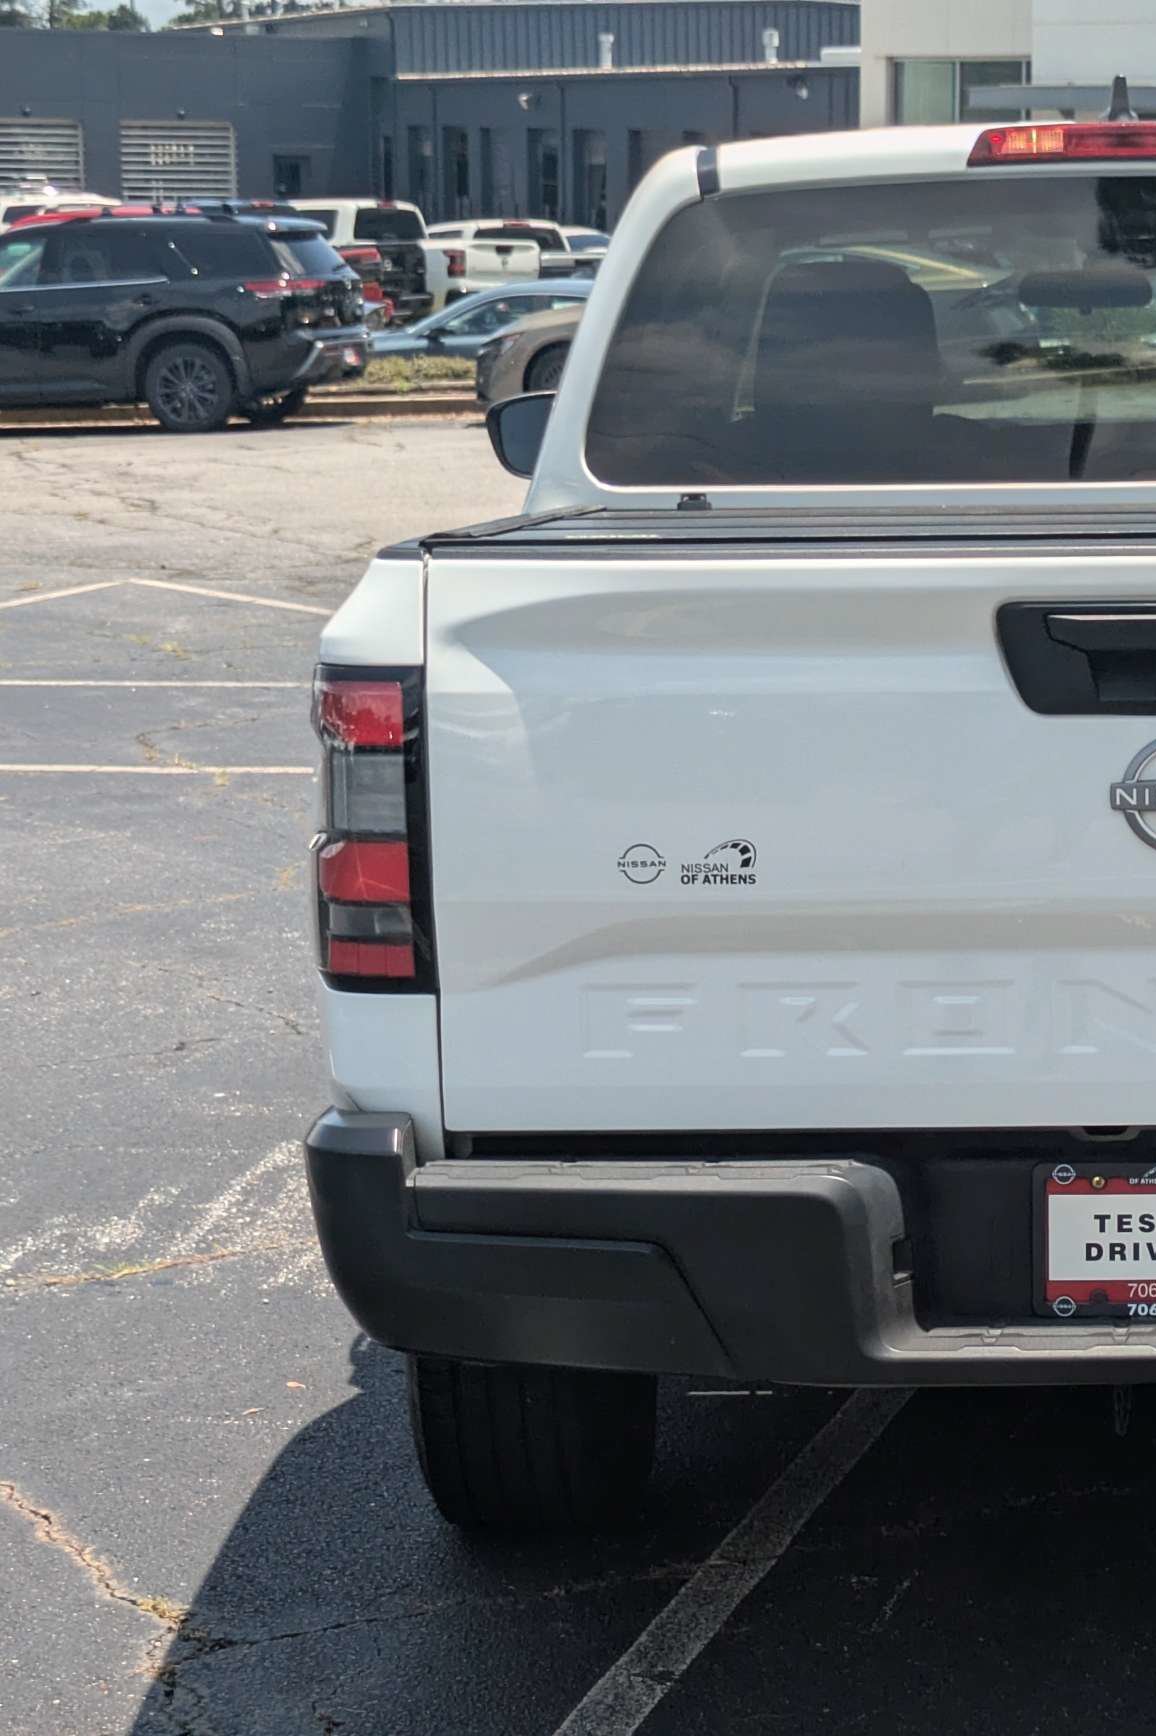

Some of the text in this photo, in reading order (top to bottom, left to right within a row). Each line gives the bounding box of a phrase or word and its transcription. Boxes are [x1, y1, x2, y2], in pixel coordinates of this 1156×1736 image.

[617, 860, 666, 868] NISSAN
[681, 863, 729, 873] NISSAN
[681, 874, 757, 885] OF ATHENS
